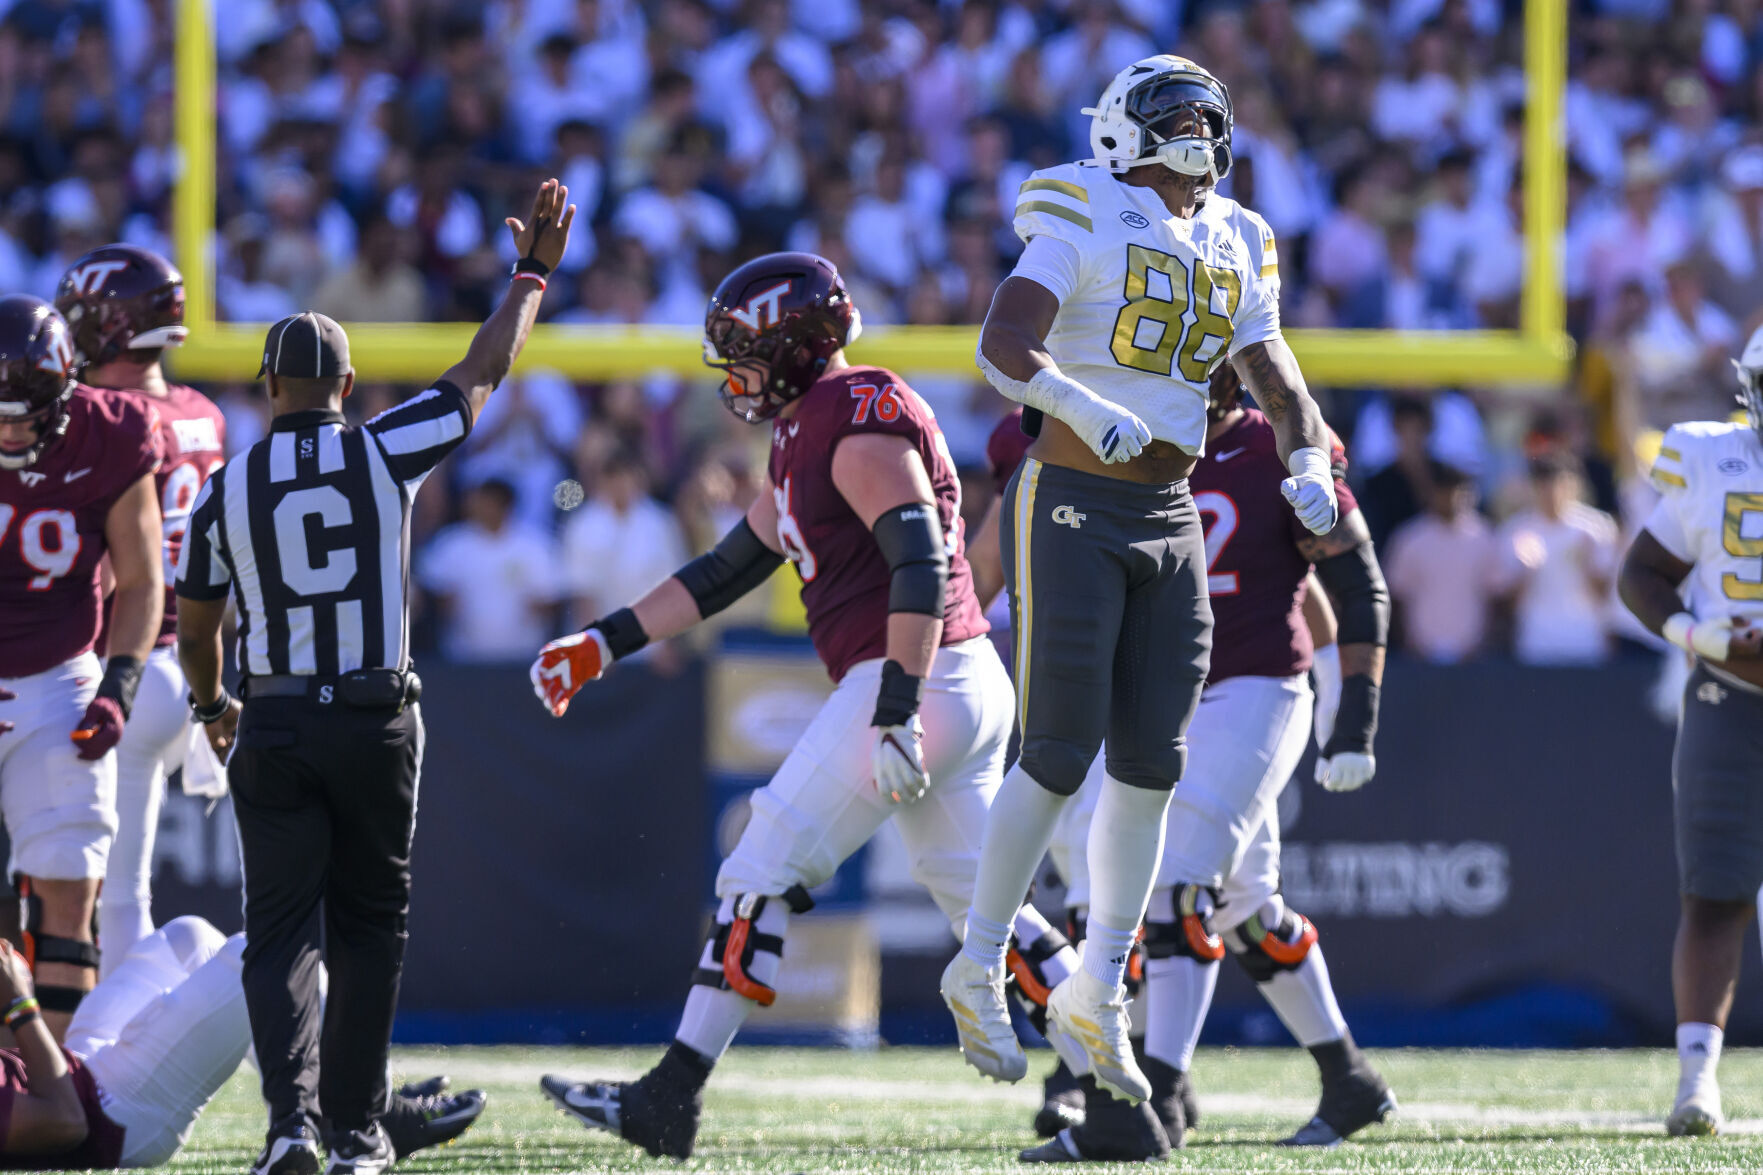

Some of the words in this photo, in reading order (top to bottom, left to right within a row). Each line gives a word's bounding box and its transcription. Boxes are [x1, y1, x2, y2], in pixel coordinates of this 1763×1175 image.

[71, 260, 130, 297] VT
[728, 280, 792, 335] VT
[1109, 243, 1242, 384] 88
[850, 384, 901, 425] 76
[18, 469, 47, 488] VT
[1052, 505, 1087, 528] GT
[273, 485, 358, 596] C
[319, 685, 334, 704] S
